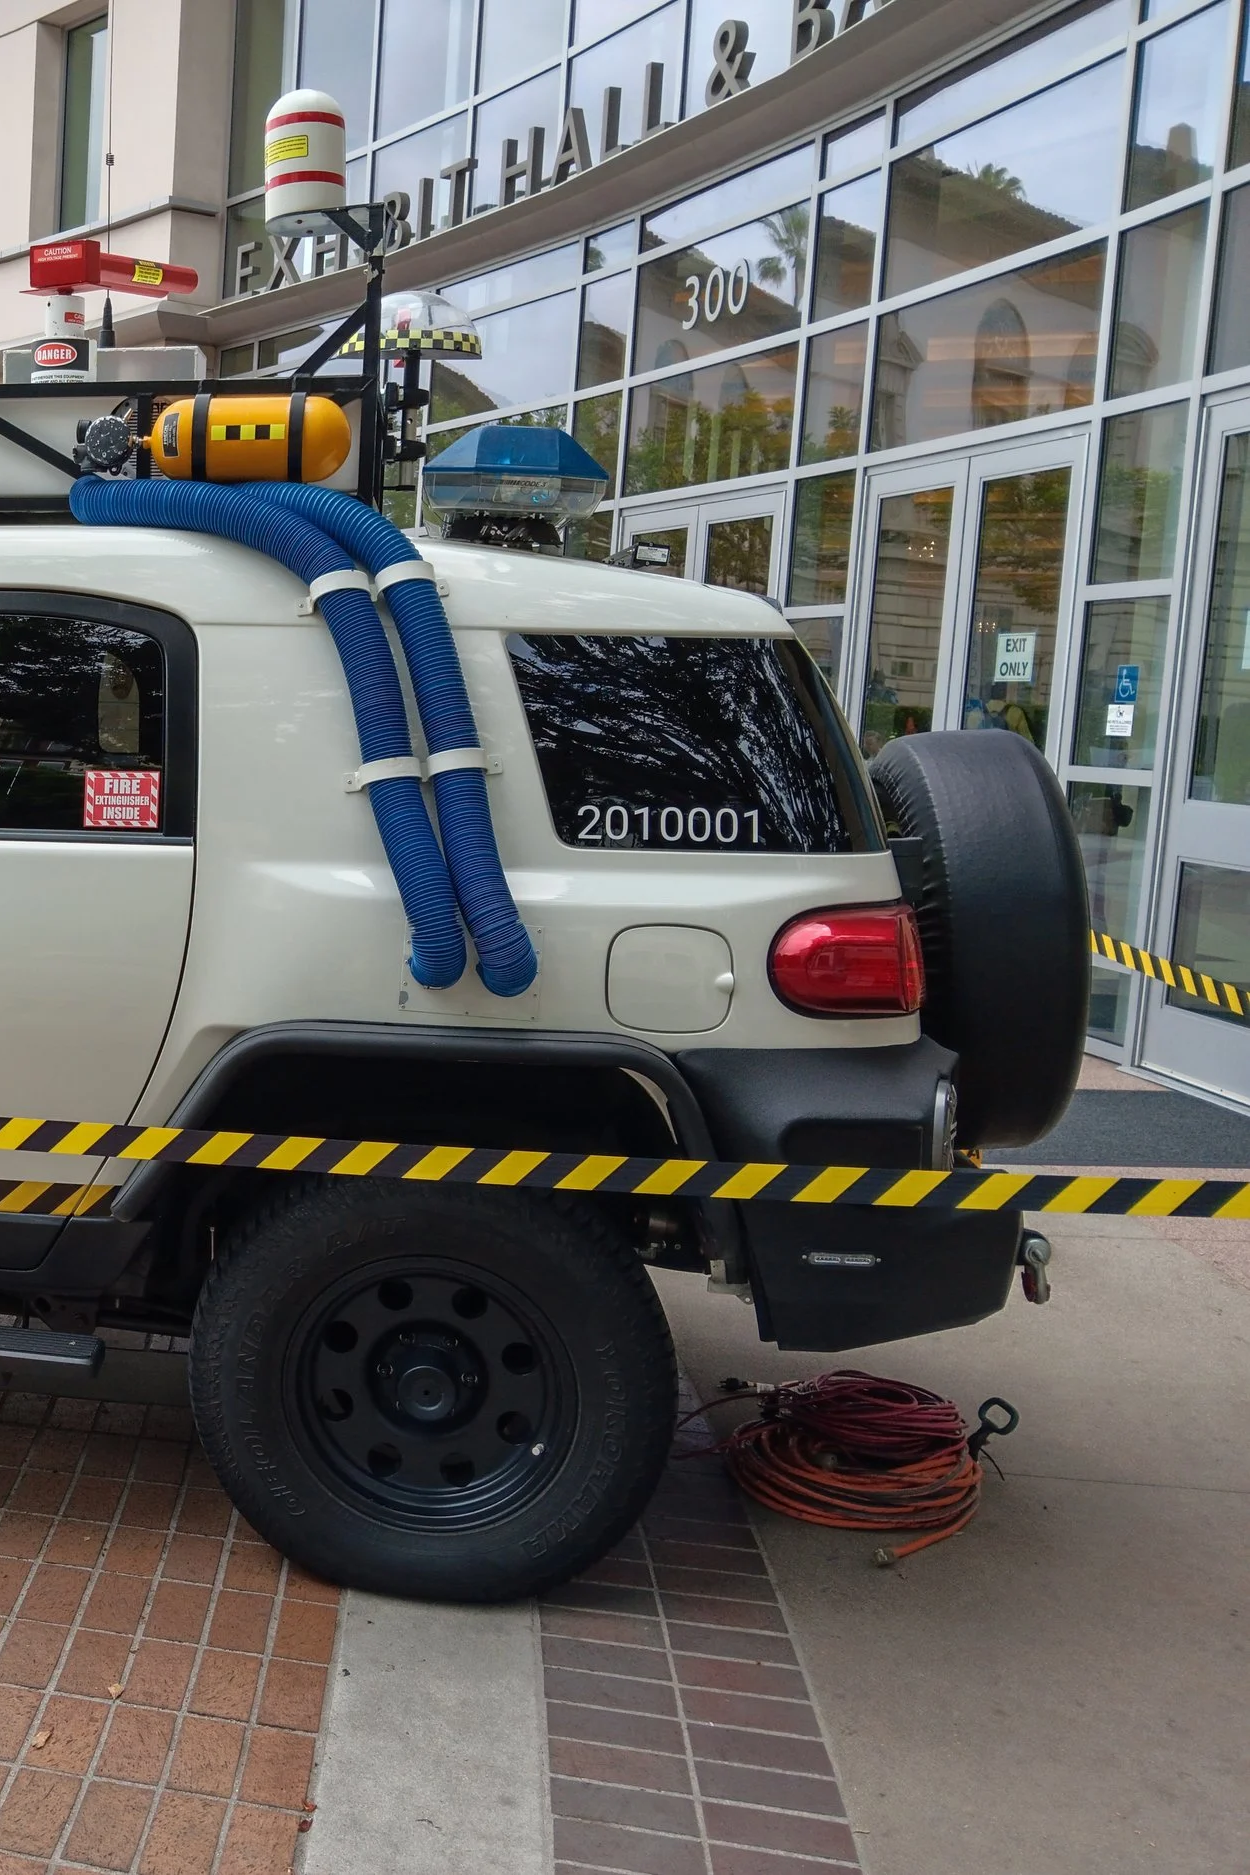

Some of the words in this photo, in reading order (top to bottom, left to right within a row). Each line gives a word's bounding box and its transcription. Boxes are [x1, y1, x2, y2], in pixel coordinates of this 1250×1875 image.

[500, 61, 677, 207] HALL
[705, 19, 757, 108] &
[43, 246, 72, 257] CAUTION
[682, 257, 749, 331] 300
[37, 348, 72, 362] DANGER
[1005, 638, 1027, 653] EXIT
[1000, 661, 1028, 676] ONLY
[104, 778, 141, 794] FIRE
[95, 795, 149, 806] EXTINGUISHER
[102, 806, 140, 820] INSIDE
[577, 805, 759, 844] 2010001
[518, 1340, 629, 1560] YOKOHAMA
